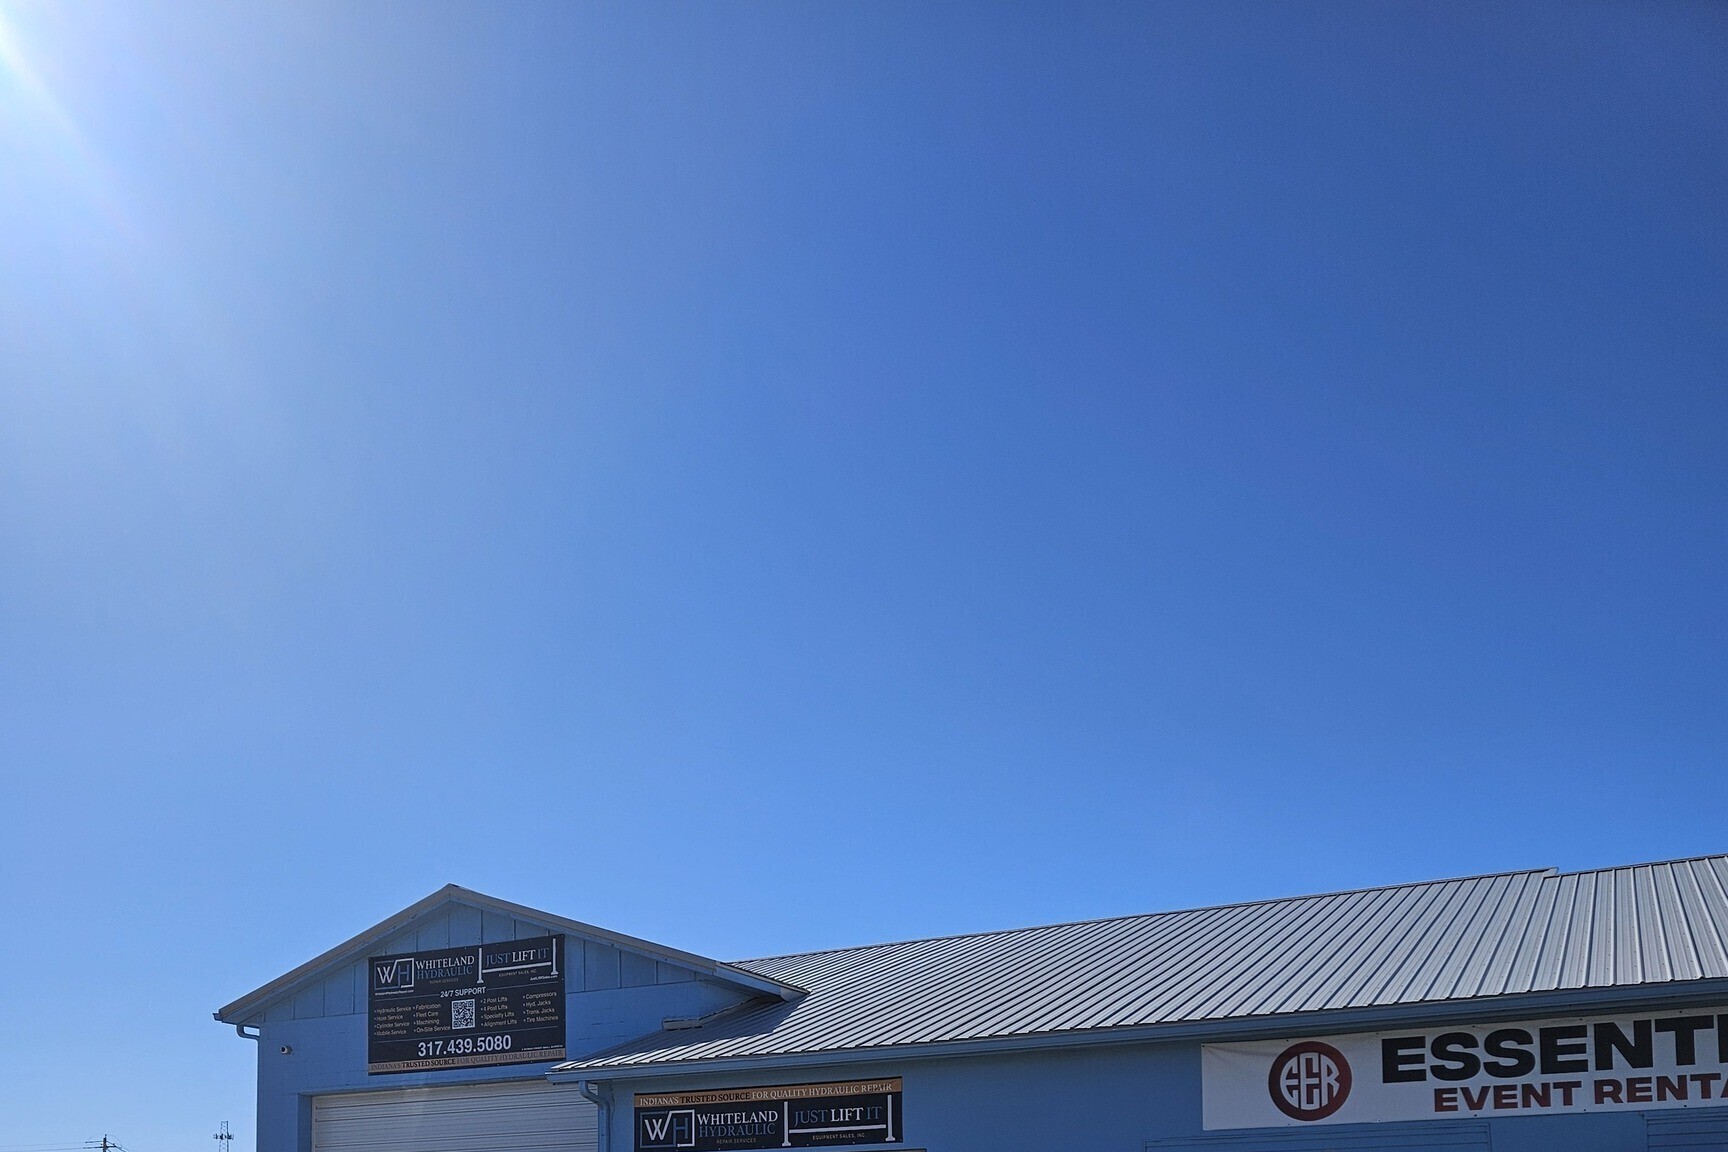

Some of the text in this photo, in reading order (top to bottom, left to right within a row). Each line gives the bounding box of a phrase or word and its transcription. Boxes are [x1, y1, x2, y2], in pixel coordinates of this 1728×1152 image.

[416, 956, 475, 970] WHITELAND
[486, 948, 549, 968] JUST LIFT IT
[417, 966, 472, 980] HYDRAULIC
[440, 986, 486, 998] 24/7 SUPPORT
[526, 992, 557, 1000] Compressors
[418, 1035, 512, 1057] 317.439.5080
[402, 1061, 430, 1069] TRUSTED
[471, 1055, 499, 1064] QUALITY
[500, 1052, 537, 1062] HYDRAULIC
[539, 1050, 562, 1058] REPAIR
[640, 1083, 892, 1106] INDIANA'S TRUSTED SOURCE FOR QUALITY HYDRAULIC REPAIR
[1434, 1073, 1728, 1112] EVENT RENT
[697, 1110, 778, 1126] WHITELAND
[794, 1106, 882, 1127] JUST LIFT IT
[699, 1123, 776, 1138] HYDRAULIC
